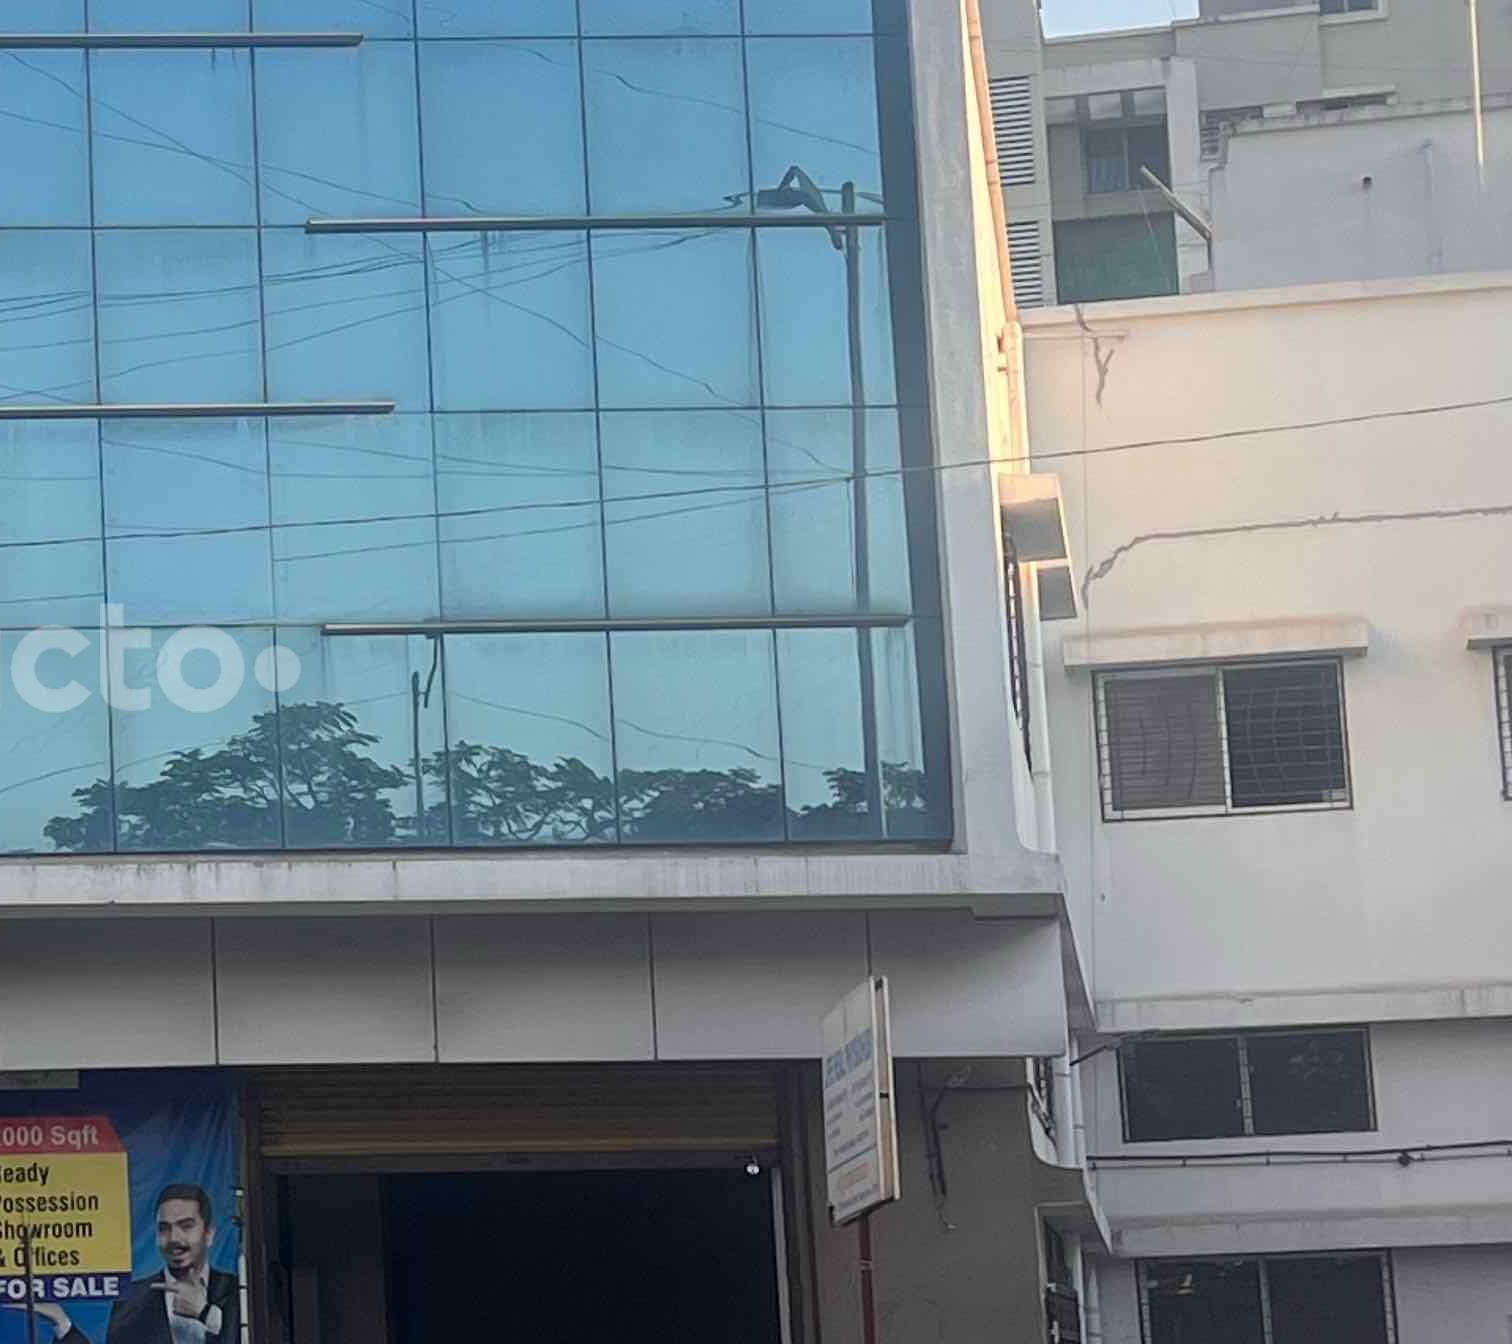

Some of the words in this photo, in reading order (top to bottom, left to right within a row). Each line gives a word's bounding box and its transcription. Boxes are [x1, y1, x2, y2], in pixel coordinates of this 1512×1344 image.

[50, 1124, 99, 1150] Sqft
[13, 1246, 80, 1268] Ofices
[53, 1276, 120, 1298] SALE
